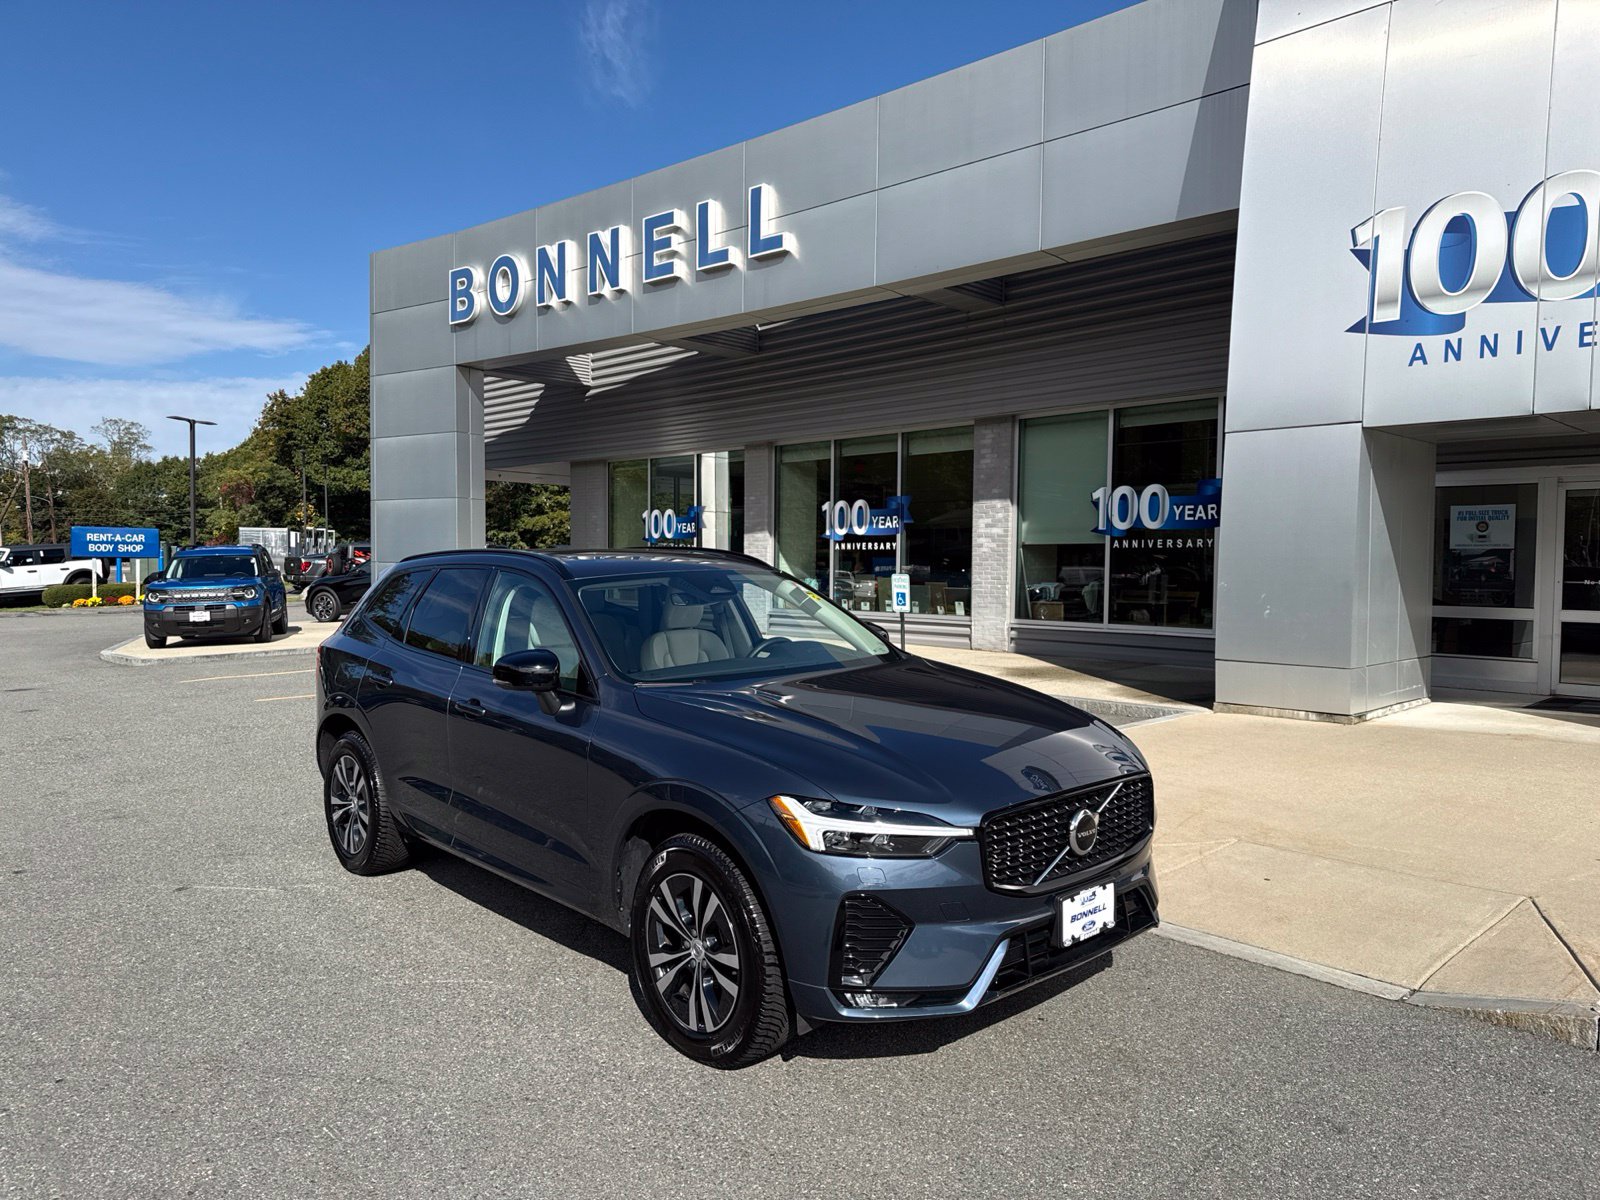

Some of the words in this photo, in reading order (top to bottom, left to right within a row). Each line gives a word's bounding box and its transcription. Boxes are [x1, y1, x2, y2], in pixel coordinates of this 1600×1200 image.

[449, 183, 790, 326] BONNELL
[1351, 169, 1600, 323] 100
[821, 499, 870, 536] 100
[872, 515, 900, 529] YEAR
[1091, 483, 1170, 531] 100
[1173, 504, 1218, 520] YEAR
[642, 508, 677, 539] 100
[86, 533, 145, 542] RENT-A-CAR
[88, 544, 114, 552] BODY
[117, 544, 144, 552] SHOP
[835, 541, 897, 550] ANNIVERSARY
[1113, 539, 1214, 549] ANNIVERSARY
[1070, 903, 1107, 923] BONNELL
